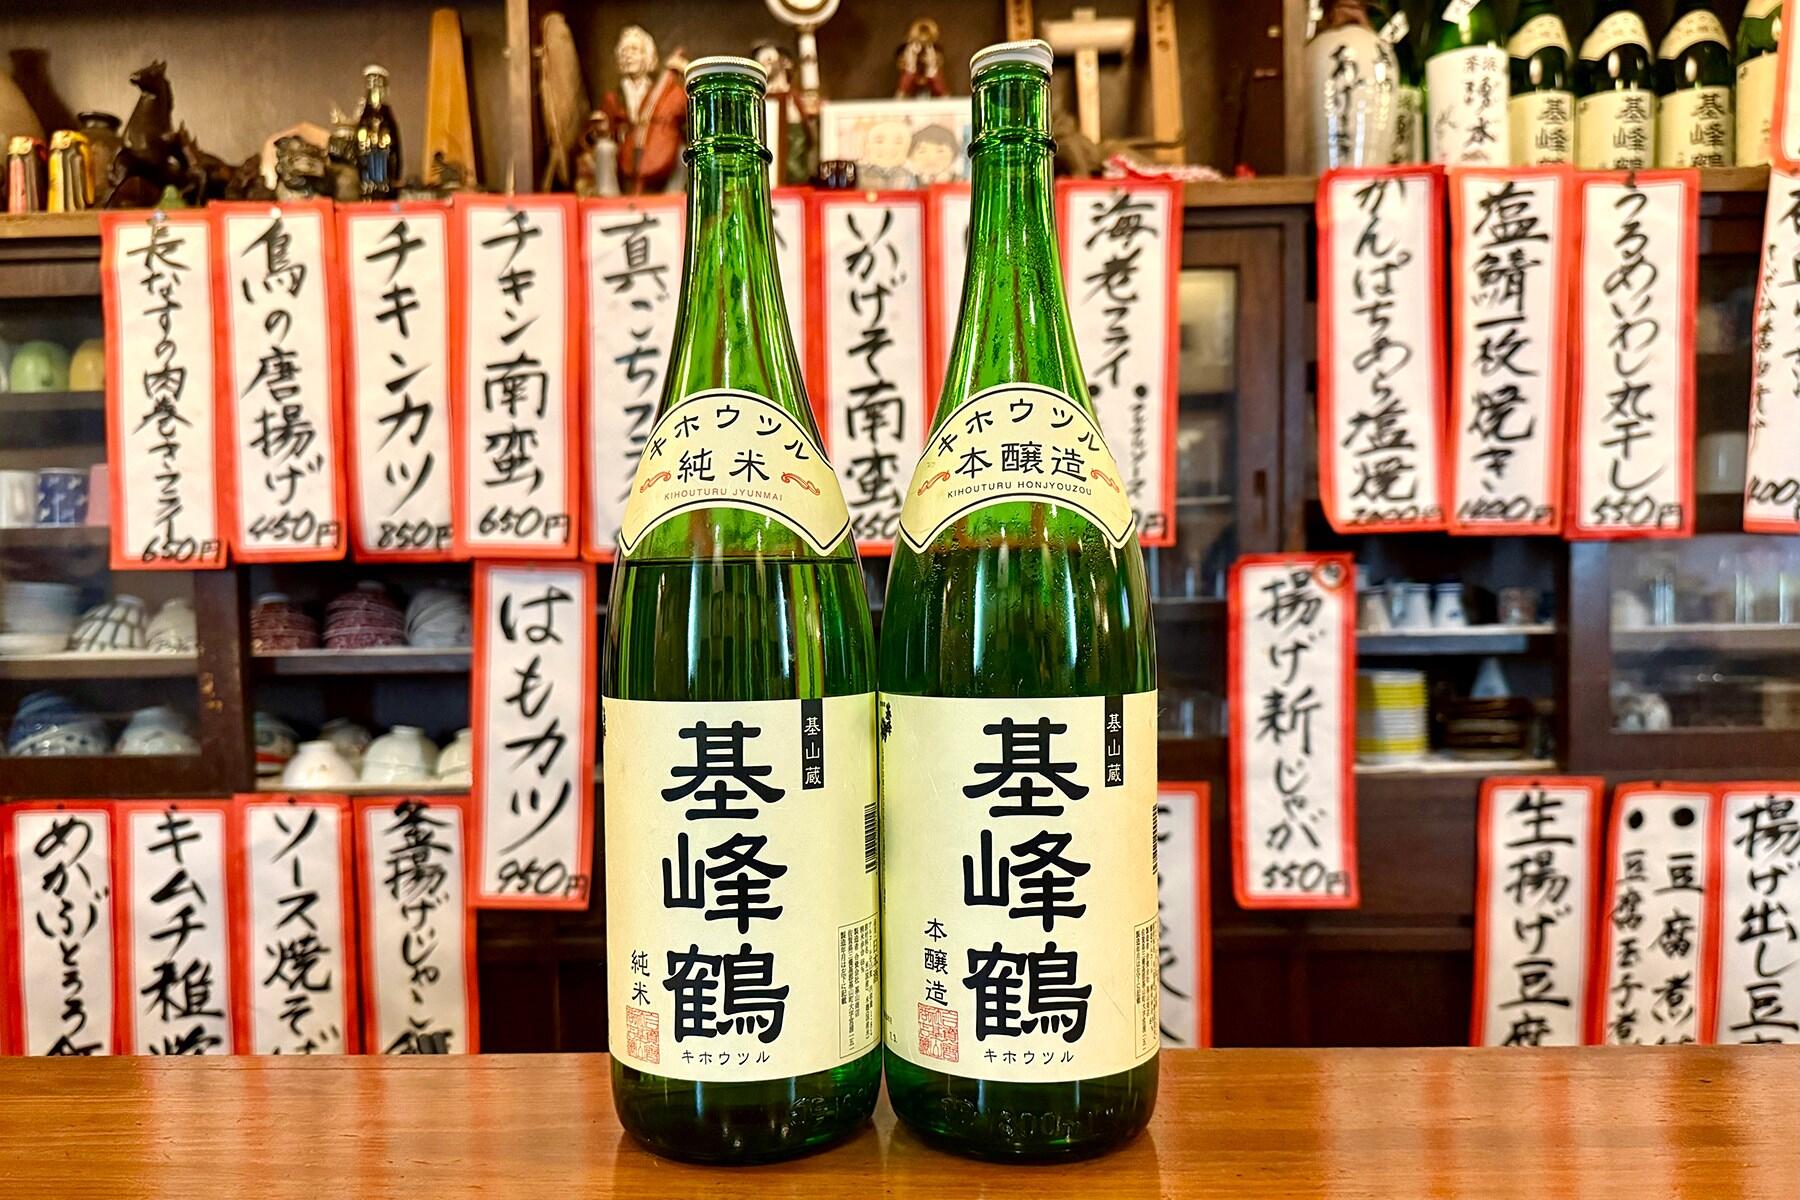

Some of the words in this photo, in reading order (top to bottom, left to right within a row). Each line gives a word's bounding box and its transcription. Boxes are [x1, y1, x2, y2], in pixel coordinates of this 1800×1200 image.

[1083, 190, 1161, 388] 海老フライ
[240, 217, 325, 506] 鳥の唐揚げ
[365, 220, 434, 516] チキンカツ
[482, 209, 550, 495] チキン南蛮
[844, 207, 907, 508] いかげそ南蛮
[1603, 174, 1666, 495] うるめいわし丸干し
[650, 404, 809, 460] キホウツル
[938, 398, 1100, 457] キホウツル
[955, 441, 1087, 482] 本醸造
[664, 488, 727, 501] KIHOUTURU
[732, 489, 783, 501] JYUNMAI
[677, 448, 770, 483] 純米
[947, 481, 1012, 499] KIHOUTURU
[1017, 480, 1093, 496] HONJYOUZOU
[250, 510, 341, 549] 450円
[478, 506, 570, 545] 650円
[1592, 495, 1682, 530] 550円
[499, 585, 574, 856] はもカツ
[1257, 566, 1329, 850] 揚げ新じゃが
[803, 716, 822, 786] 基山蔵
[1106, 712, 1123, 783] 基山蔵
[498, 858, 589, 900] 950円
[660, 720, 790, 1044] 基峰鶴
[962, 716, 1093, 1043] 基峰鶴
[1262, 862, 1351, 897] 550円
[34, 816, 110, 1055] めかぶとろろ
[1648, 853, 1704, 1044] 豆腐煮
[1731, 795, 1800, 1044] 揚げ出し豆
[631, 949, 651, 1006] 純米
[923, 917, 950, 1007] 本醸造
[681, 1049, 770, 1065] キホウツル
[983, 1048, 1075, 1065] キホウツル
